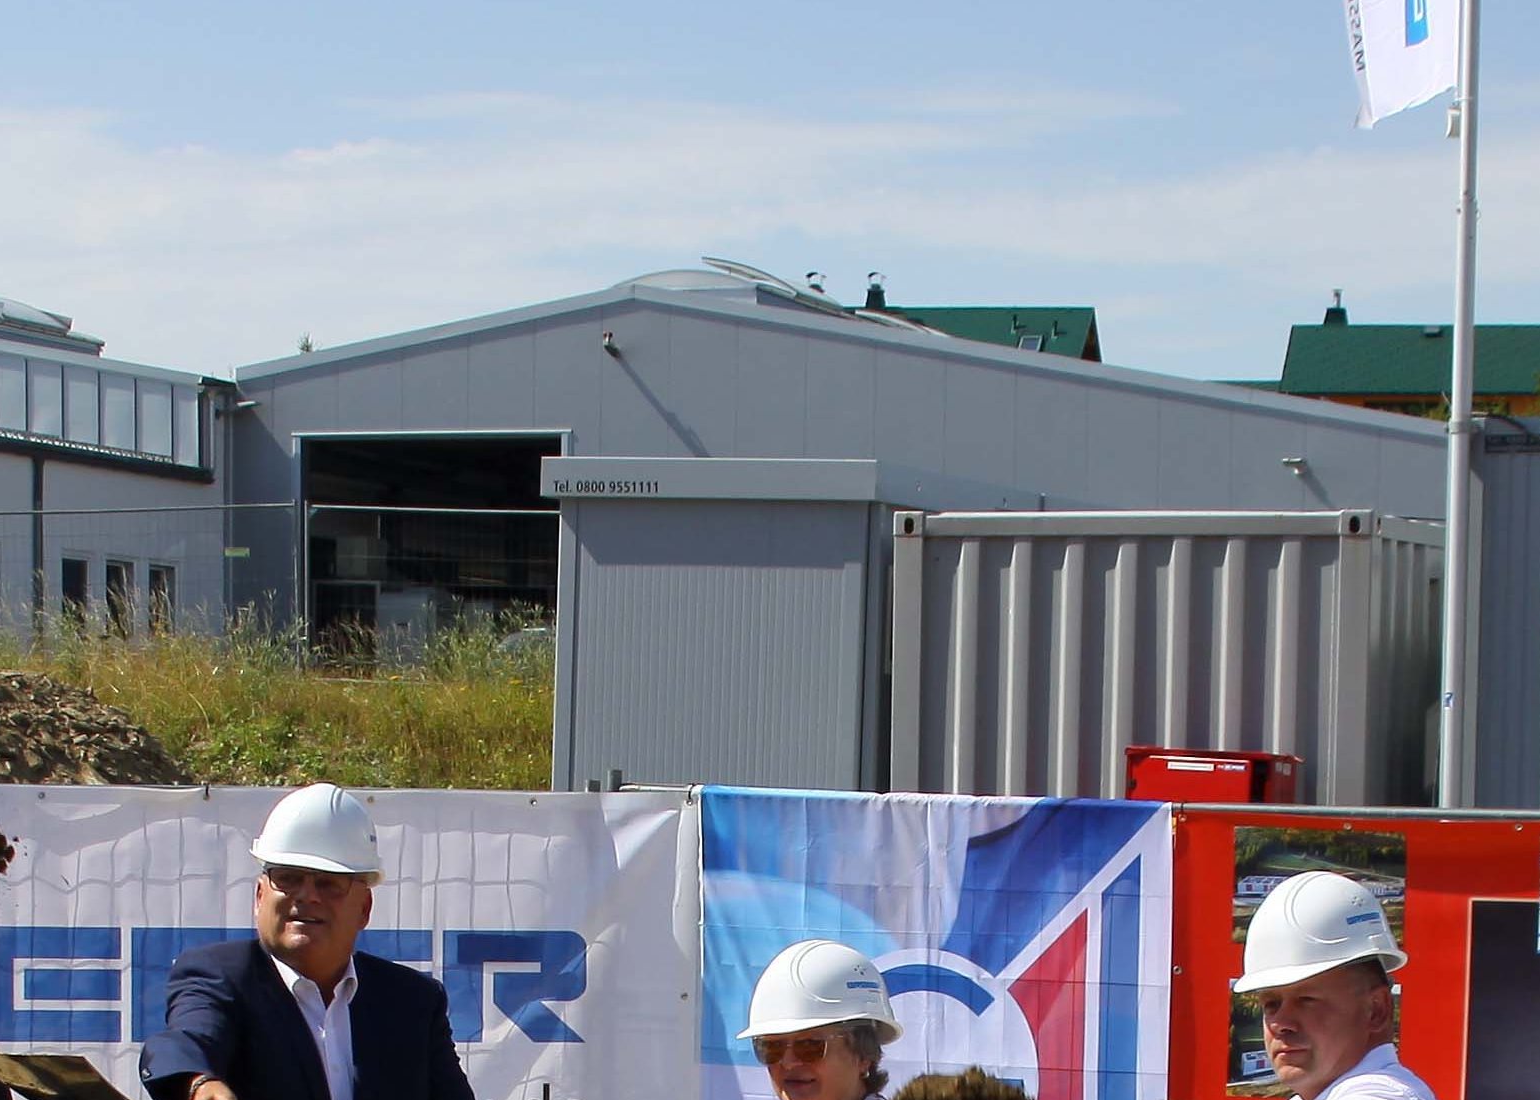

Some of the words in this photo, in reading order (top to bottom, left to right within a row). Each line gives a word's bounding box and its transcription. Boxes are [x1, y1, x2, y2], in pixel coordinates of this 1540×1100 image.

[554, 480, 572, 493] Tel.
[576, 480, 605, 493] 0800
[609, 481, 659, 493] 9551111
